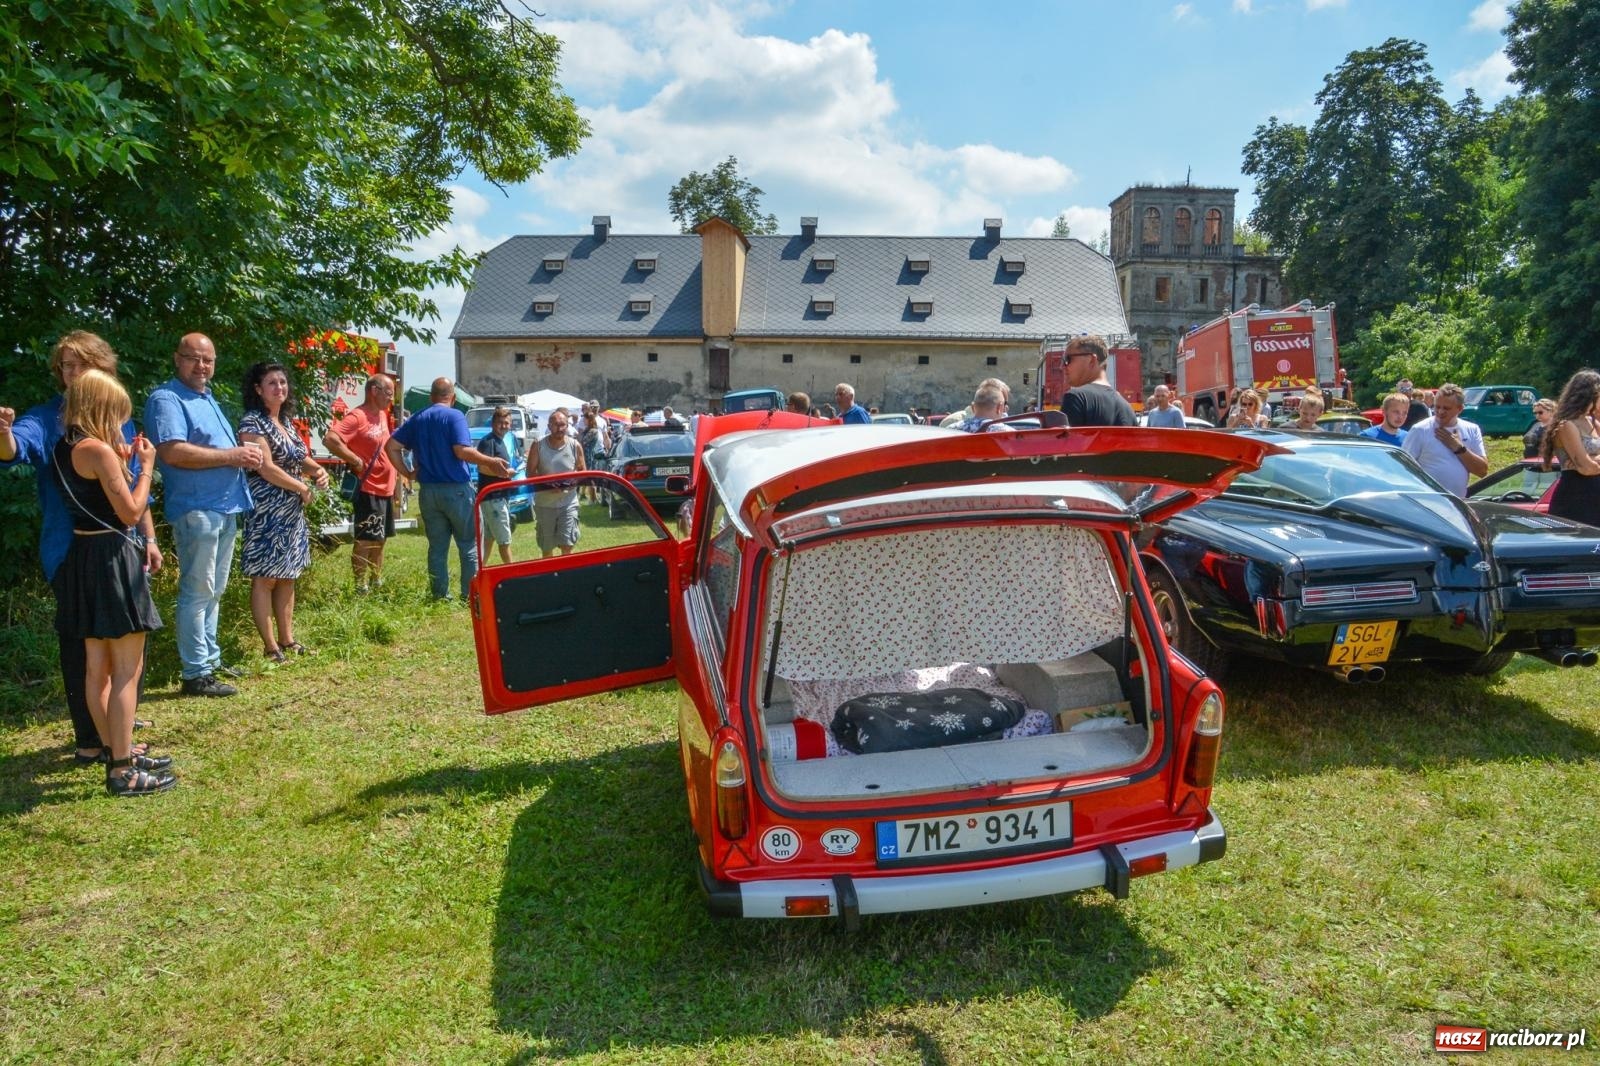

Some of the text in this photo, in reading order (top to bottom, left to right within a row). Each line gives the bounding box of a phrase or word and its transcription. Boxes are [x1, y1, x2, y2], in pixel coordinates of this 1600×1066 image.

[1350, 624, 1382, 643] SGL
[1336, 645, 1364, 663] 2V
[903, 807, 1056, 853] 7M2 9341
[771, 833, 791, 847] 80
[830, 834, 850, 844] RY
[775, 848, 790, 857] km
[881, 844, 895, 854] CZ
